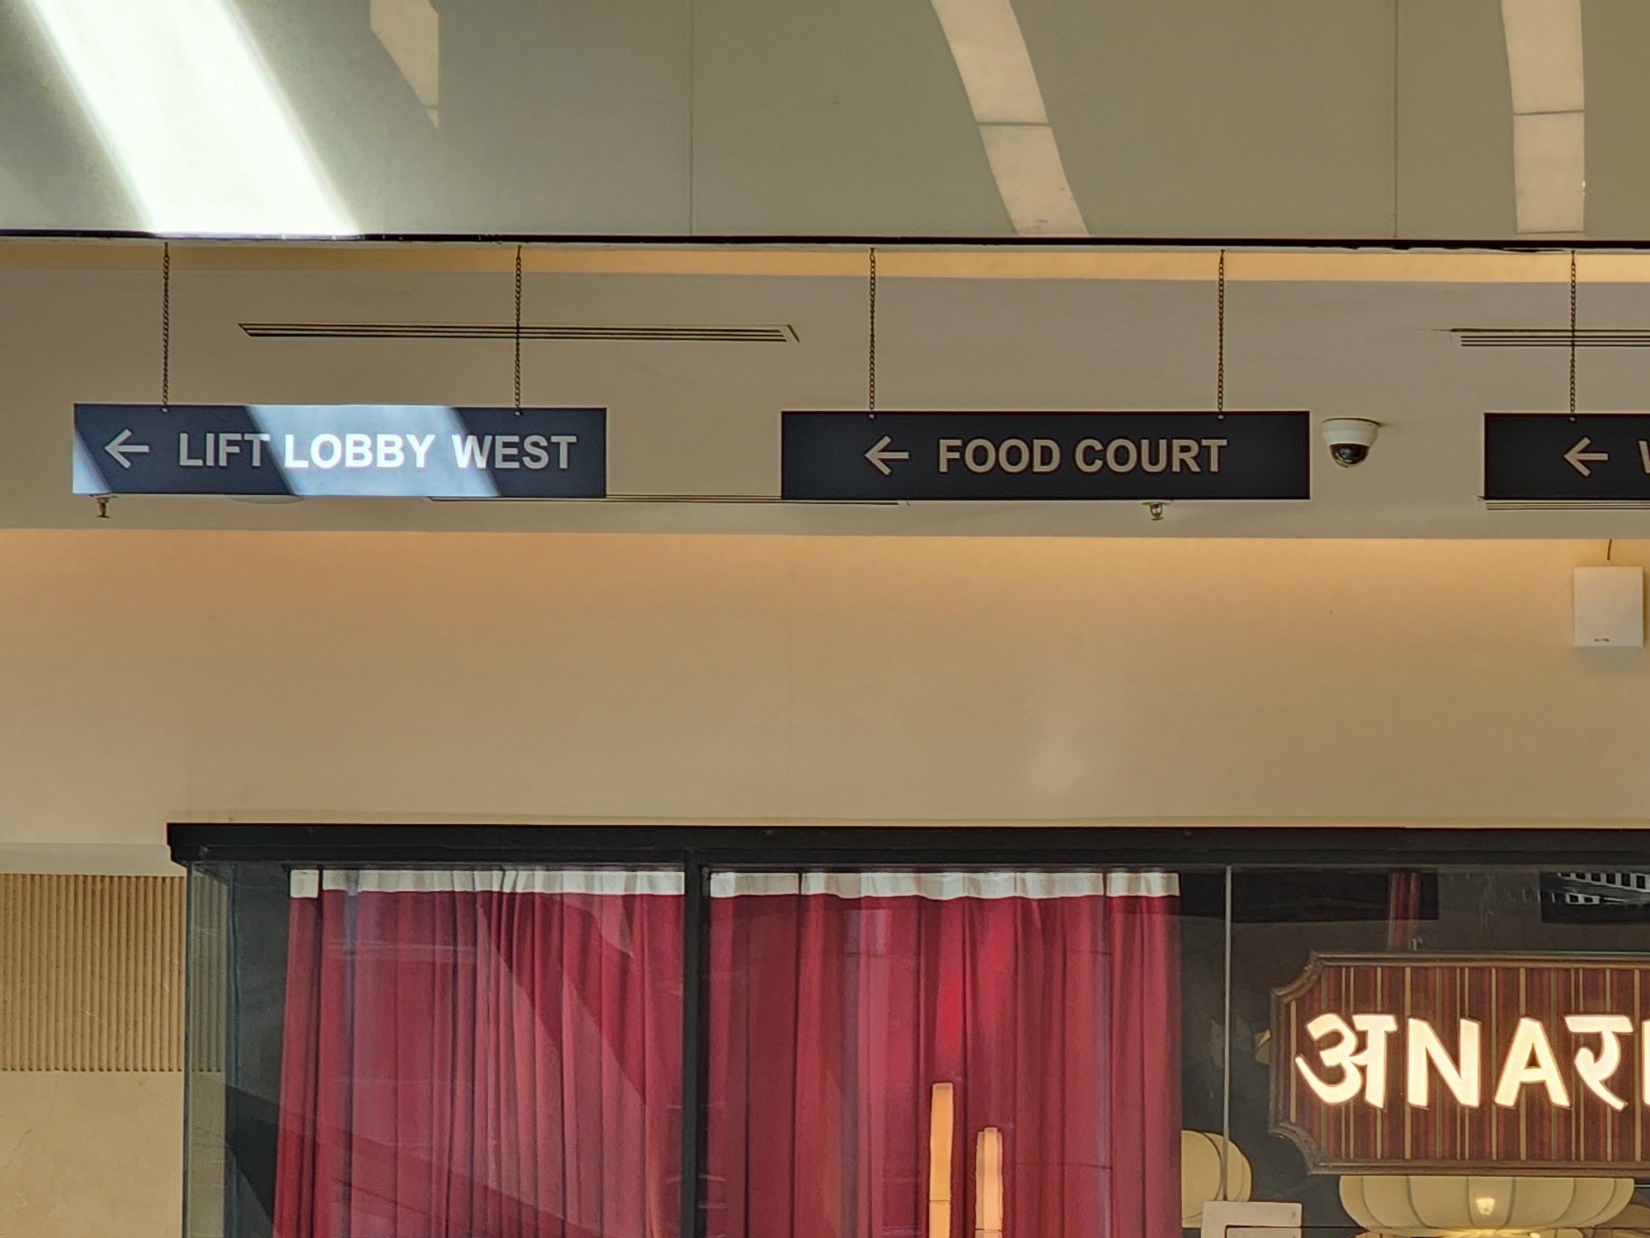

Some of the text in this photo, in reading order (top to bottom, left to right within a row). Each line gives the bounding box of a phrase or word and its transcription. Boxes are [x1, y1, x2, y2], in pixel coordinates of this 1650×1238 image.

[178, 431, 578, 471] LIFT LOBBY WEST
[938, 438, 1229, 476] FOOD COURT
